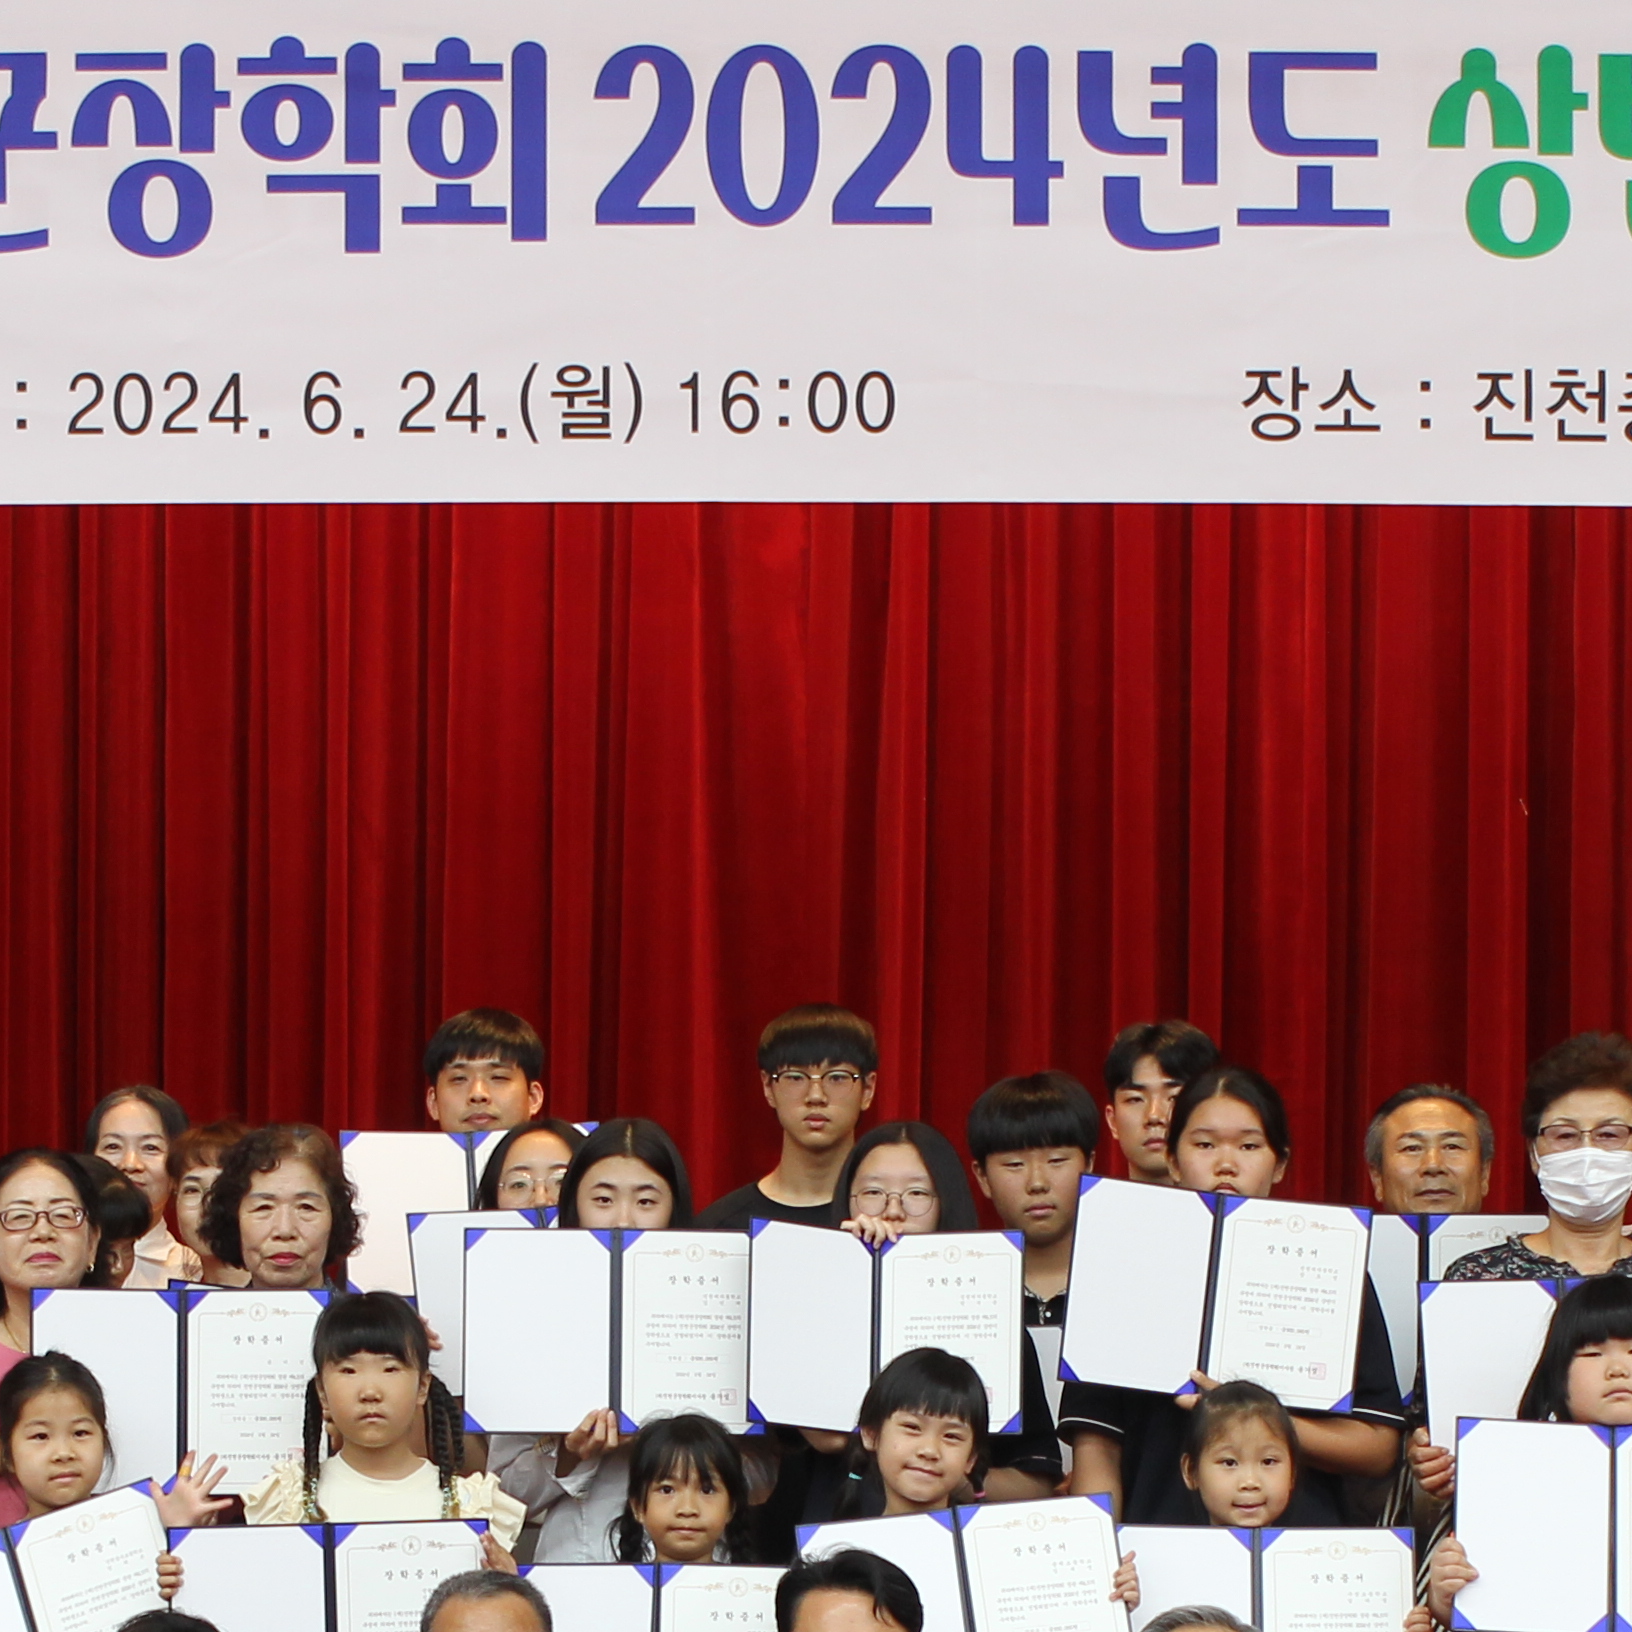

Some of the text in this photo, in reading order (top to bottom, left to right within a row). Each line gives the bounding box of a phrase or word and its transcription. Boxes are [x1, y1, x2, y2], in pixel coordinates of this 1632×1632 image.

[593, 42, 1391, 252] 2024년도
[67, 370, 270, 439] 2024.
[302, 370, 365, 439] 6.
[678, 370, 896, 434] 16:00
[1241, 366, 1382, 442] 장소
[384, 1568, 439, 1581] 장학증서
[709, 1610, 764, 1623] 장학증서
